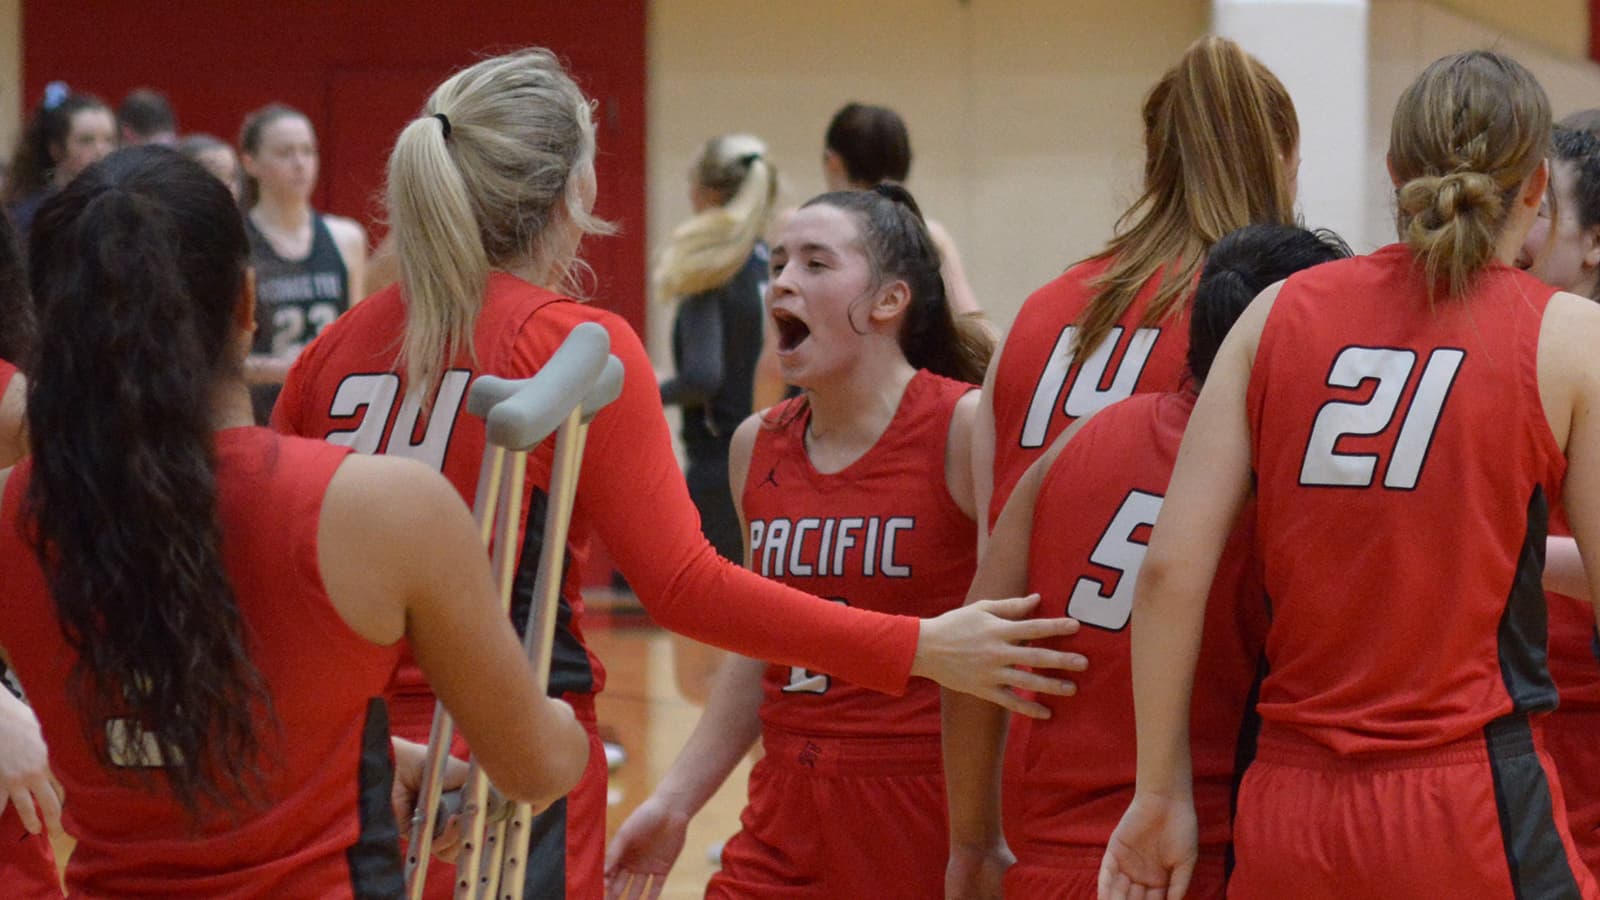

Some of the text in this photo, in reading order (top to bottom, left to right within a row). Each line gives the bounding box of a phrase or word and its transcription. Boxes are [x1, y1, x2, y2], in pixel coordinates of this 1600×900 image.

[1020, 324, 1161, 448] 14
[1298, 344, 1467, 491] 21
[750, 515, 915, 578] PACIFIC
[1066, 488, 1165, 633] 5
